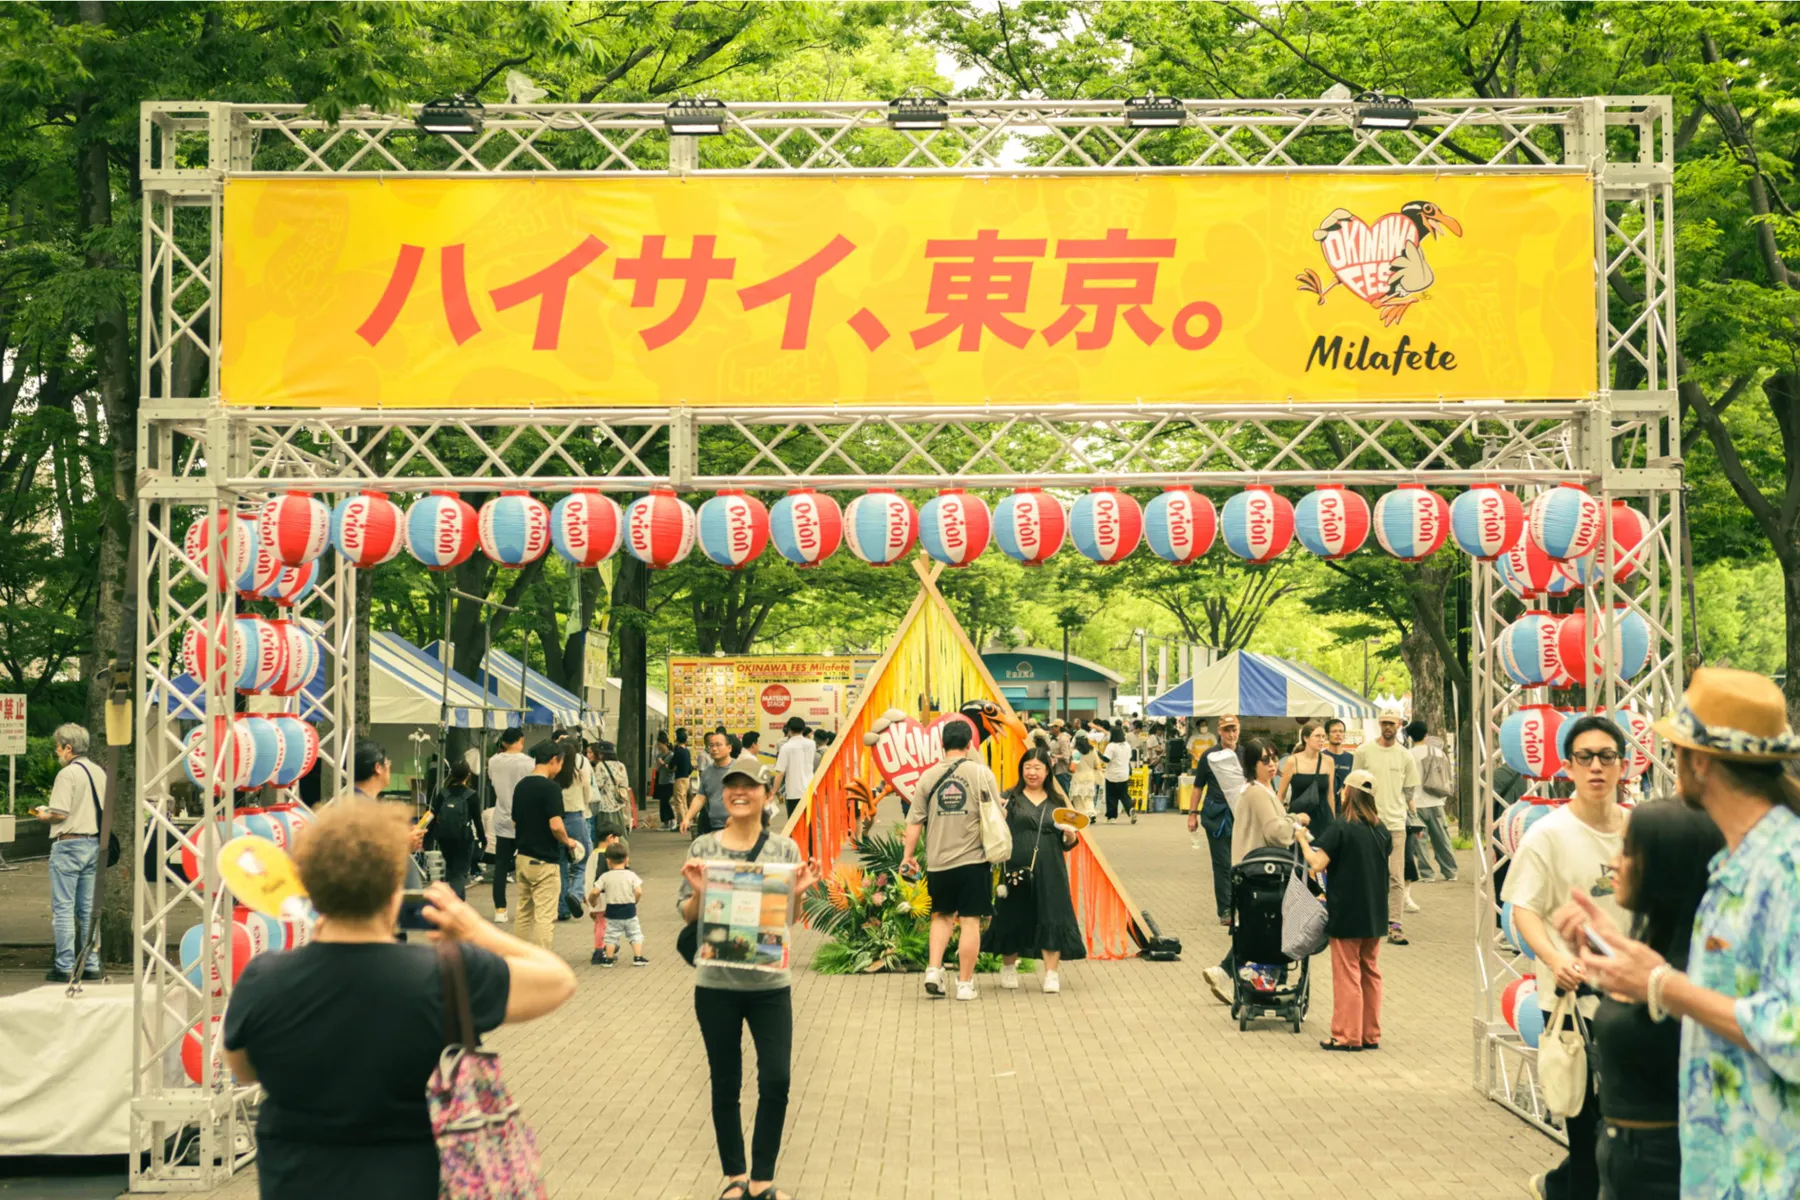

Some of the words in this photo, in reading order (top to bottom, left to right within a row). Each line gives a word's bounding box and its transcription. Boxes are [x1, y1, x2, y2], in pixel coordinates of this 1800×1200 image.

[356, 229, 1222, 351] ハイサイ、東京。
[1337, 262, 1392, 299] FES
[1305, 335, 1459, 376] Milafete
[261, 501, 278, 547] Orion
[344, 503, 366, 549] Orion
[439, 507, 460, 554] Orion
[527, 505, 546, 551] Orion
[567, 501, 588, 548] Orion
[632, 504, 649, 550] Orion
[730, 505, 752, 552] Orion
[795, 502, 818, 549] Orion
[889, 502, 908, 548] Orion
[942, 502, 964, 548] Orion
[1017, 502, 1038, 547] Orion
[1097, 500, 1119, 545] Orion
[1168, 500, 1191, 546] Orion
[1251, 499, 1271, 545] Orion
[1320, 497, 1343, 542] Orion
[1418, 497, 1439, 542] Orion
[1482, 497, 1504, 543] Orion
[1575, 501, 1600, 548] Orion
[185, 524, 199, 571] Orio
[1511, 544, 1525, 573] ion
[260, 627, 280, 672] Orion
[737, 663, 788, 673] OKINAWA
[790, 663, 808, 672] FES
[809, 662, 851, 672] Milafete
[1541, 624, 1558, 668] Orion
[1524, 720, 1543, 764] Orion
